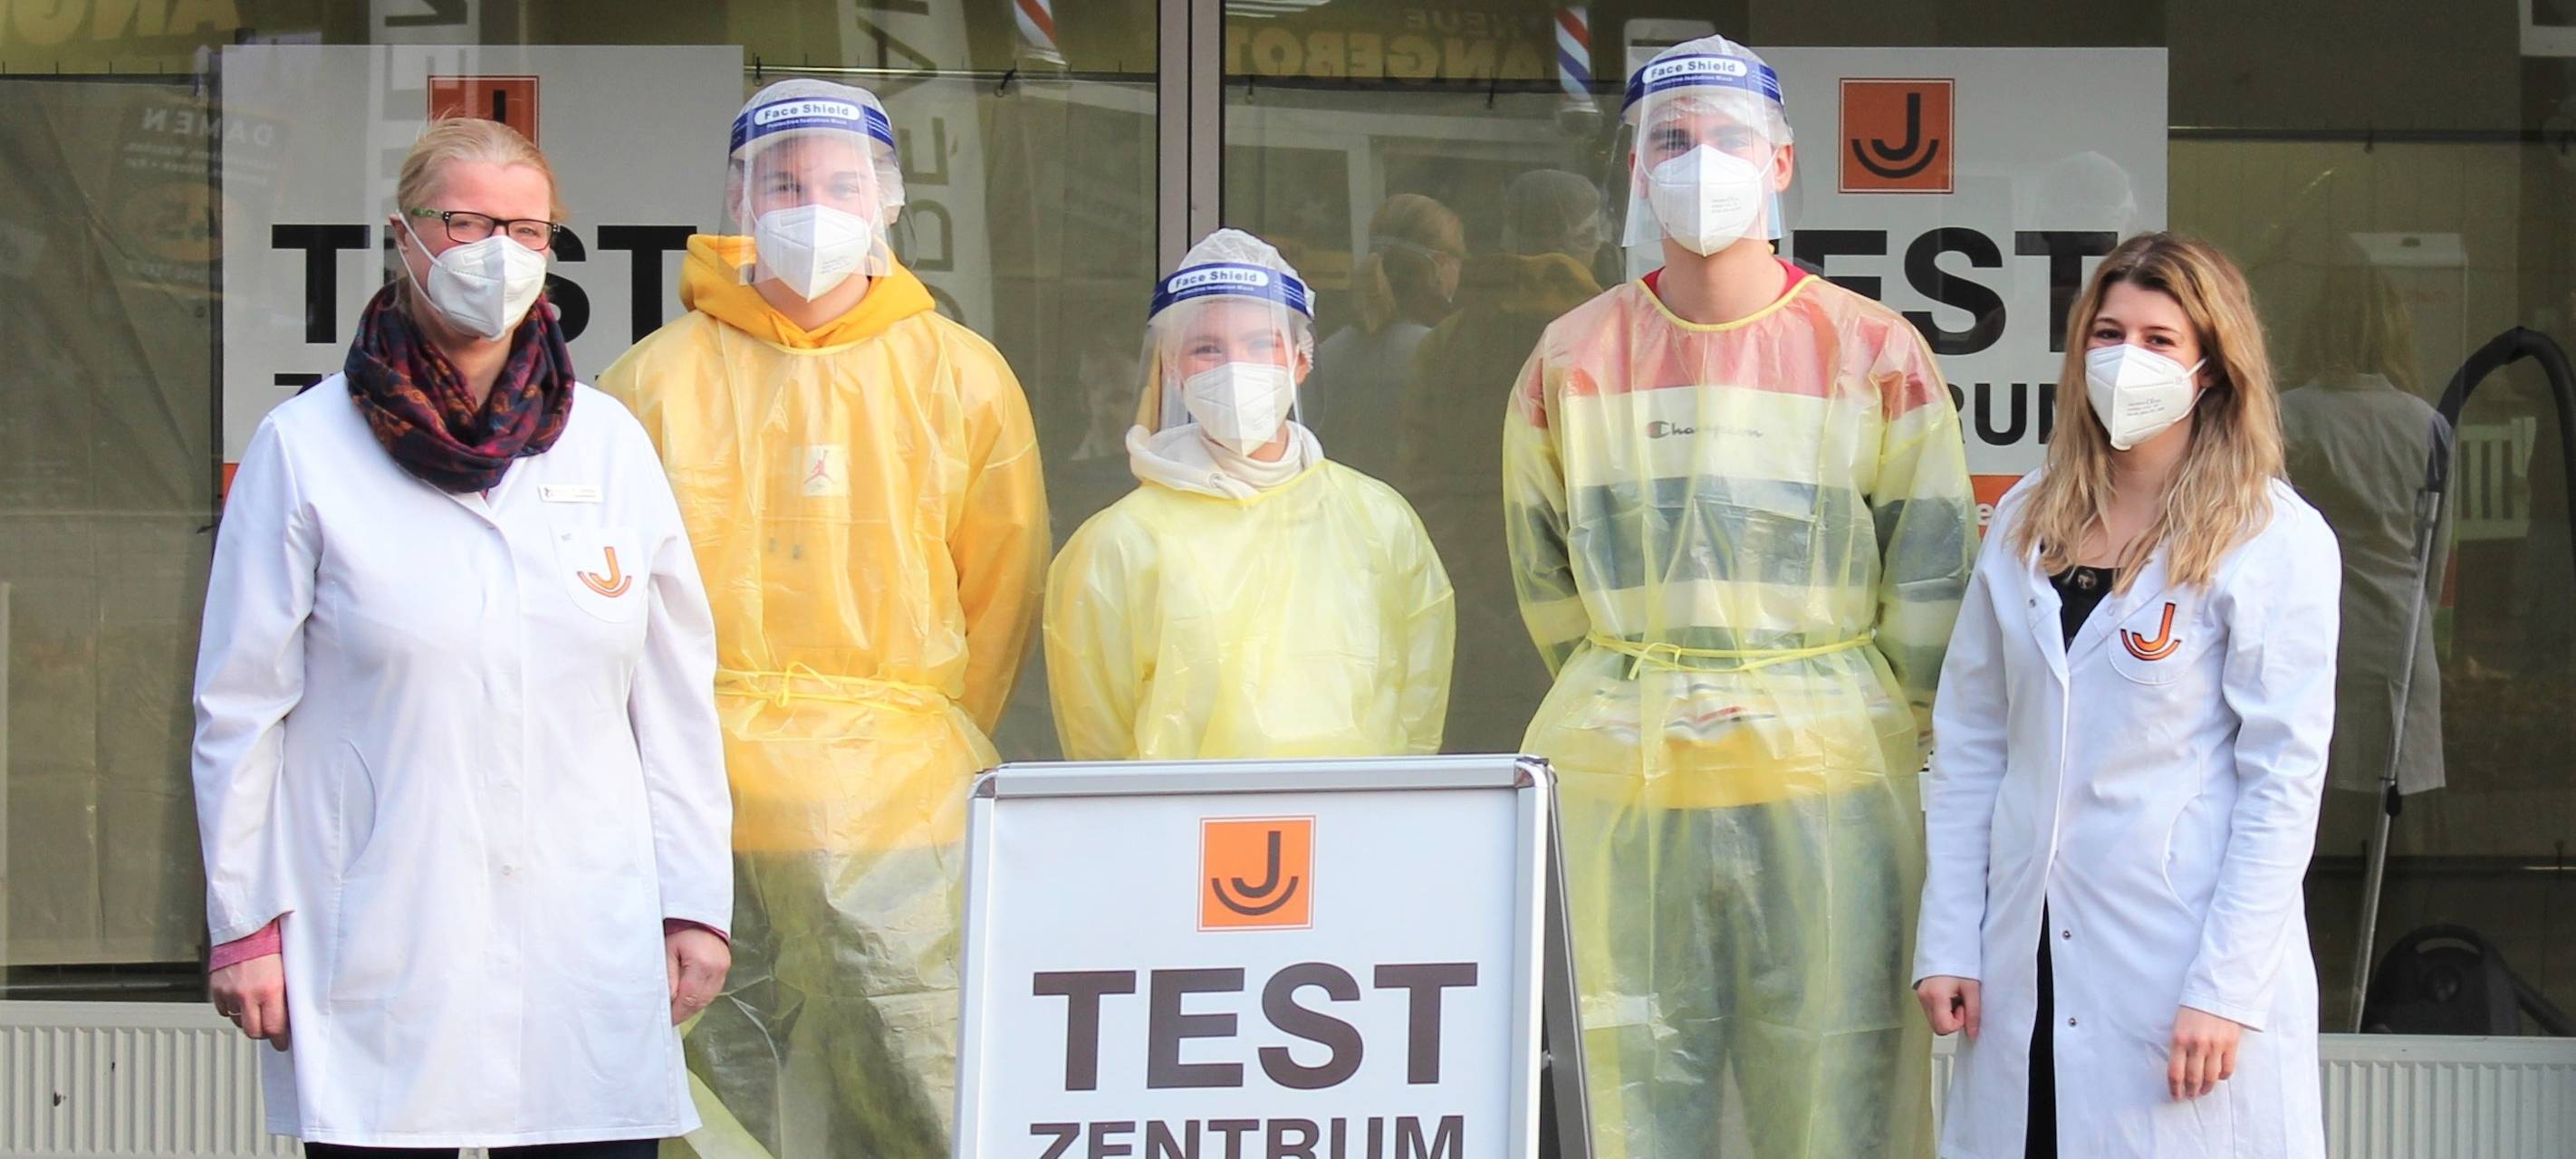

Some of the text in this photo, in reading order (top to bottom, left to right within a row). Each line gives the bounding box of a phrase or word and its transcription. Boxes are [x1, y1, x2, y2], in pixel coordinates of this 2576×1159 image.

[1650, 60, 1736, 78] Face Shield
[764, 103, 850, 120] Face Shield
[273, 225, 697, 344] TT
[1176, 270, 1257, 288] Face Shield
[1771, 227, 2118, 354] EST
[1033, 962, 1478, 1091] TEST
[1029, 1115, 1465, 1159] ZENTRUM
